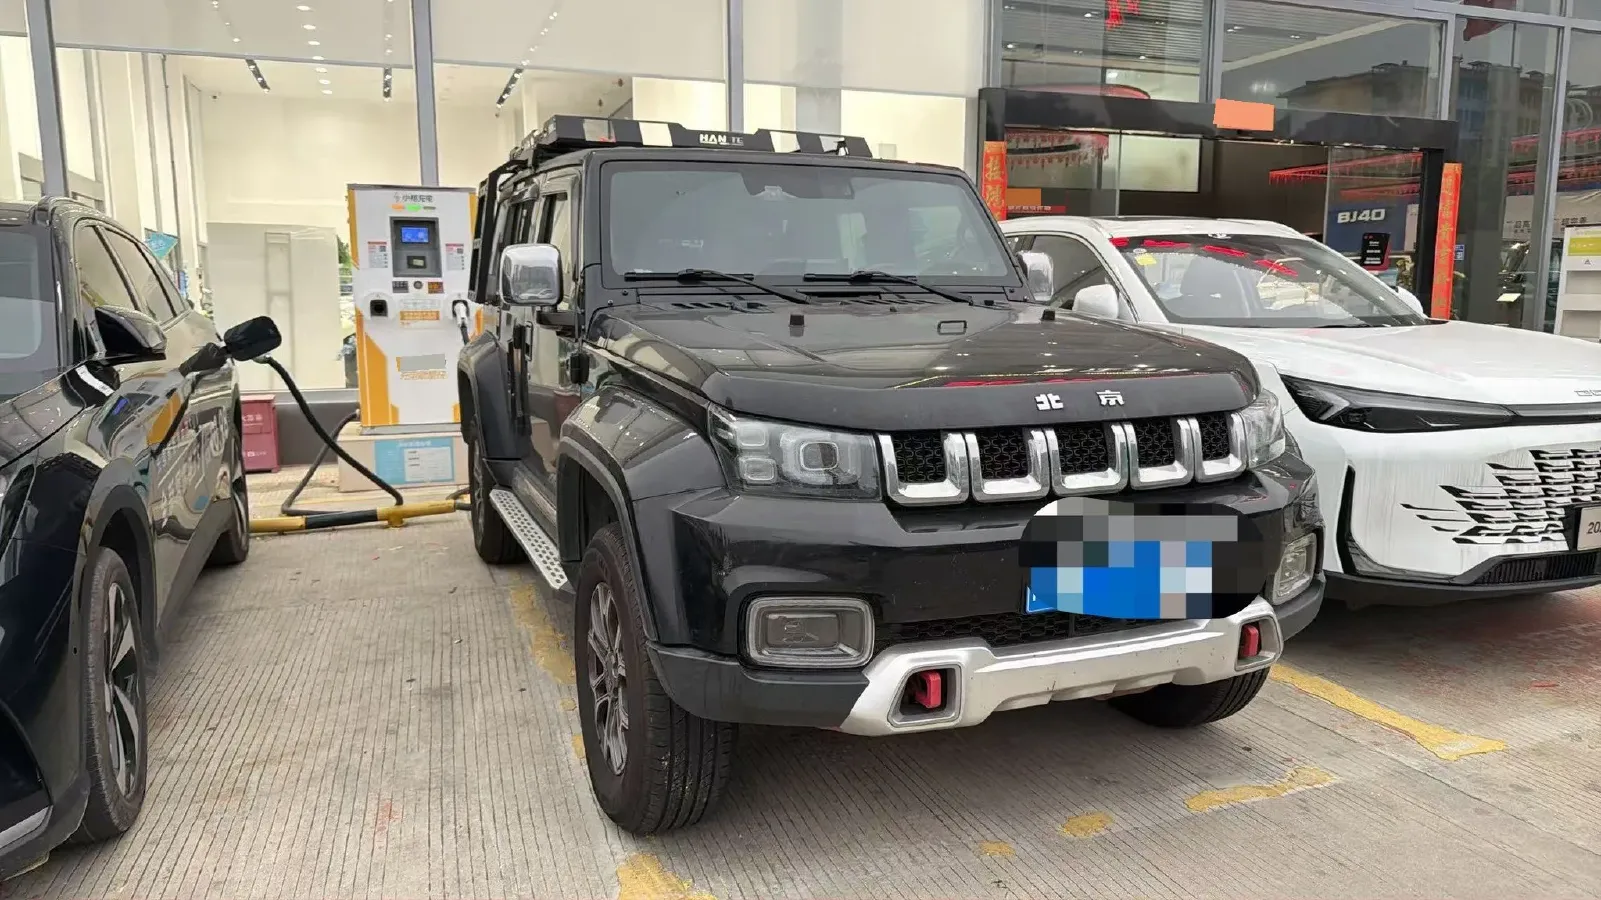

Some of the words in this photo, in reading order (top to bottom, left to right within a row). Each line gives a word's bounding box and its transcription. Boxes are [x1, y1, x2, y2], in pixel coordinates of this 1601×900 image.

[699, 133, 728, 145] HAN
[1337, 208, 1386, 224] BJ40
[1034, 389, 1125, 411] 北京
[1586, 521, 1601, 535] 20
